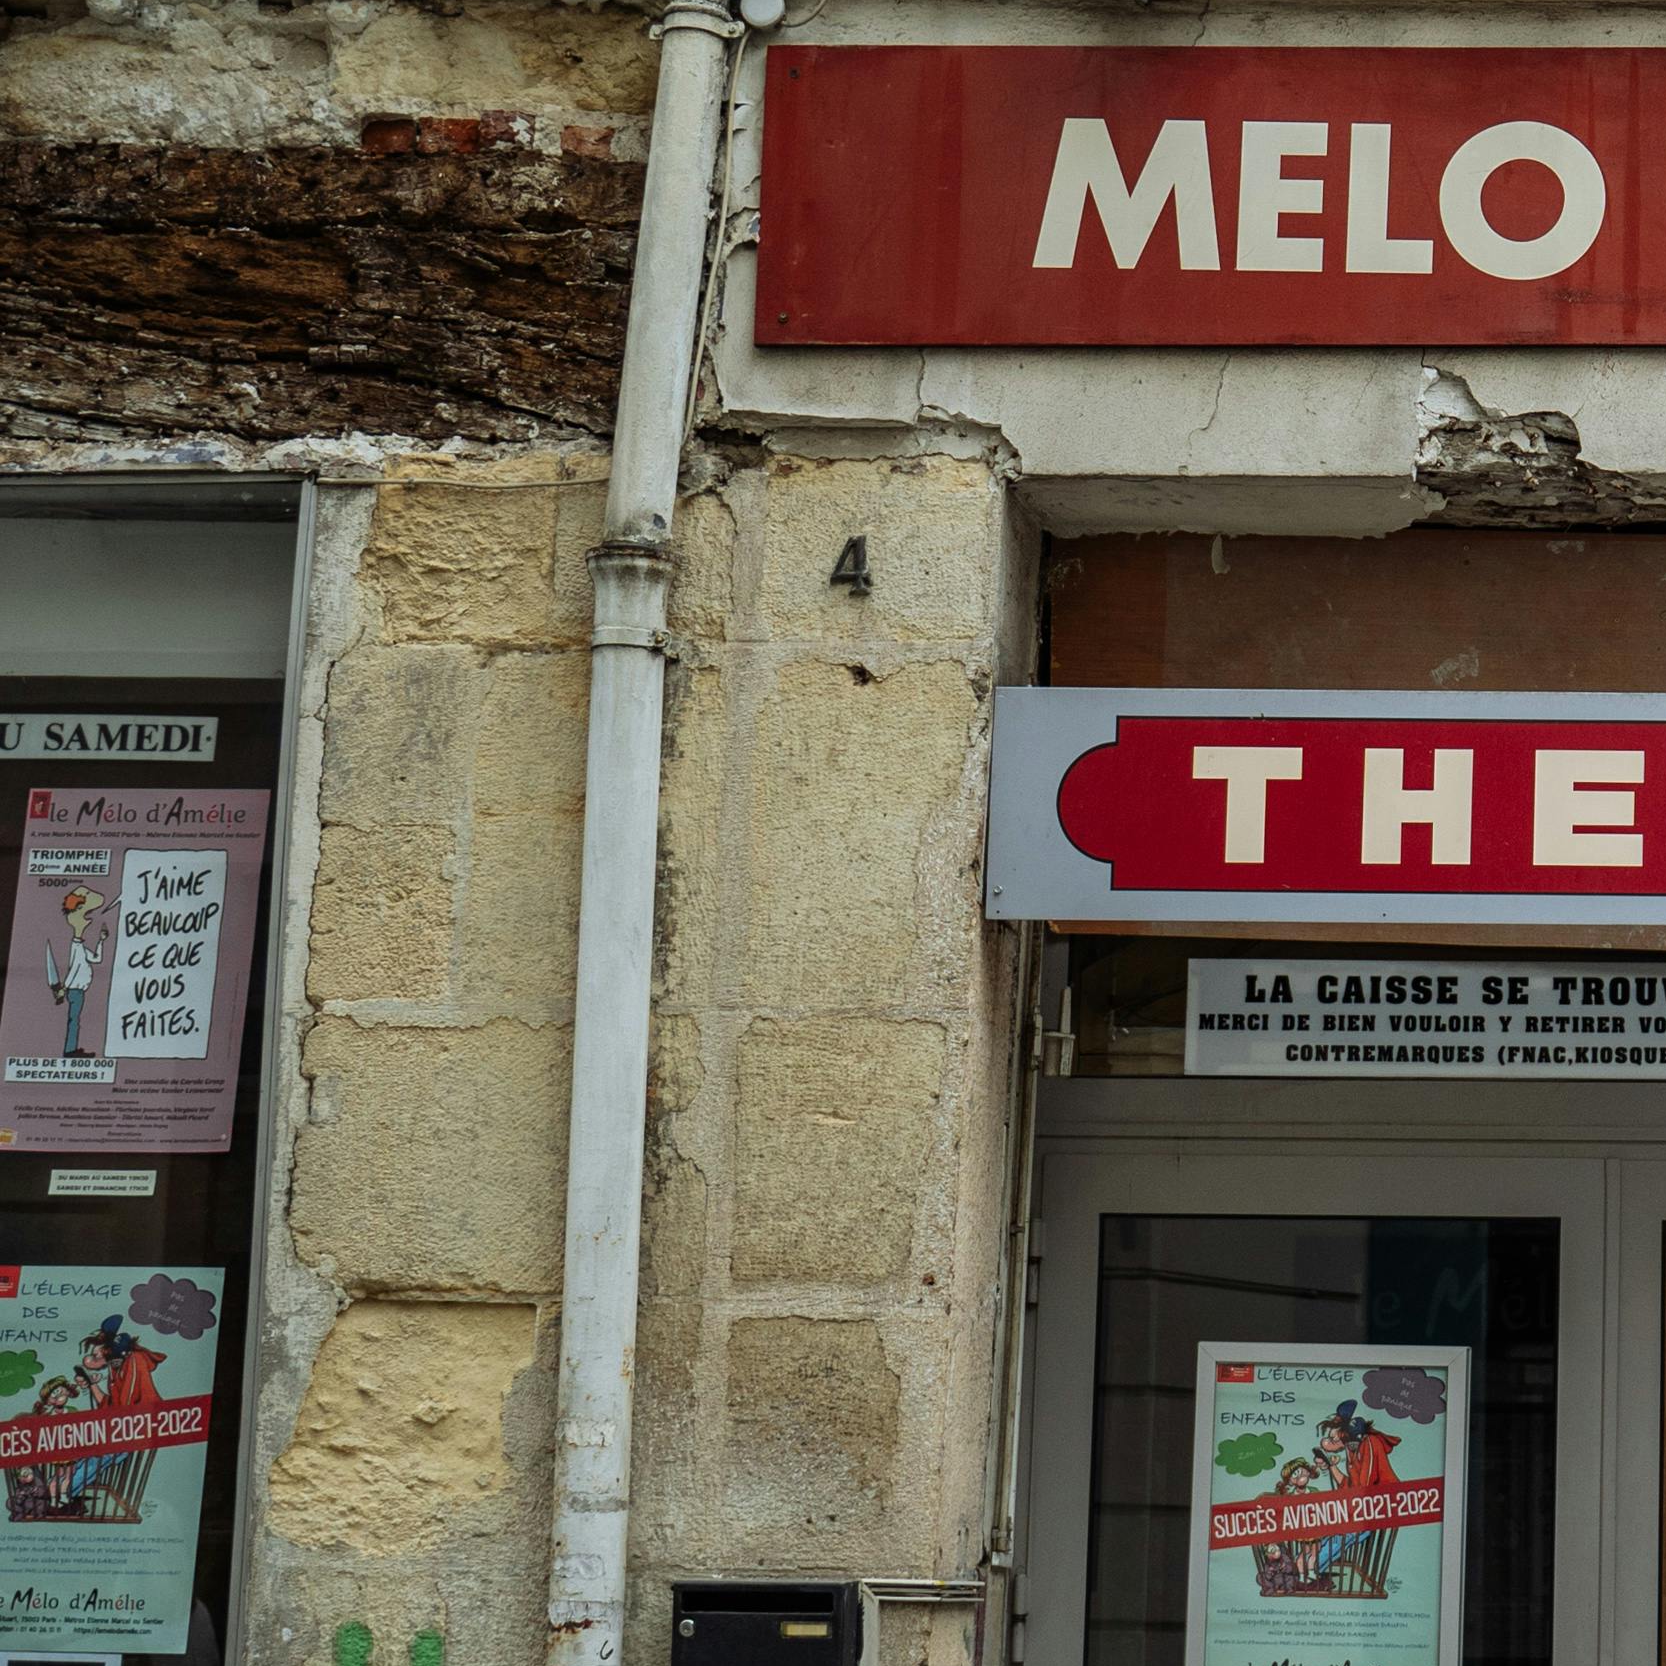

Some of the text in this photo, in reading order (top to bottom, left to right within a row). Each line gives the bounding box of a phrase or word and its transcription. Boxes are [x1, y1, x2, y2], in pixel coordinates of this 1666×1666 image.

[1032, 118, 1609, 279] MELO
[830, 535, 873, 595] 4
[51, 796, 247, 828] le Mélo d'Amélie
[32, 850, 108, 860] TRIOMPHE!
[64, 863, 107, 873] ANNÉE
[126, 903, 218, 937] BEAUCOUP
[128, 942, 205, 969] CE QUE
[135, 974, 185, 1003] VOUS
[1246, 975, 1293, 1005] LA
[1317, 975, 1459, 1006] CAISSE
[1483, 976, 1528, 1006] SE
[1199, 1014, 1268, 1032] MERCI
[1282, 1014, 1312, 1032] DE
[1323, 1014, 1376, 1033] BIEN
[1390, 1014, 1486, 1033] VOULOIR
[1498, 1015, 1513, 1033] Y
[1525, 1015, 1625, 1034] RETIRER
[9, 1059, 114, 1068] PLUS DE 1 800 000
[1285, 1044, 1486, 1066] CONTREMARQUES
[16, 1070, 97, 1080] SPECTATEURS
[21, 1280, 122, 1299] L'ÉLEVAGE
[22, 1307, 60, 1319] DES
[1257, 1365, 1355, 1384] L'ÉLEVAGE
[1260, 1392, 1296, 1403] DES
[37, 1418, 107, 1453] AVIGNON
[111, 1406, 203, 1443] 2021-2022
[1220, 1413, 1306, 1425] ENFANTS
[1214, 1488, 1441, 1539] SUCCÈS AVIGNON 2021-2022
[11, 1587, 145, 1613] Mélo d'Amélie
